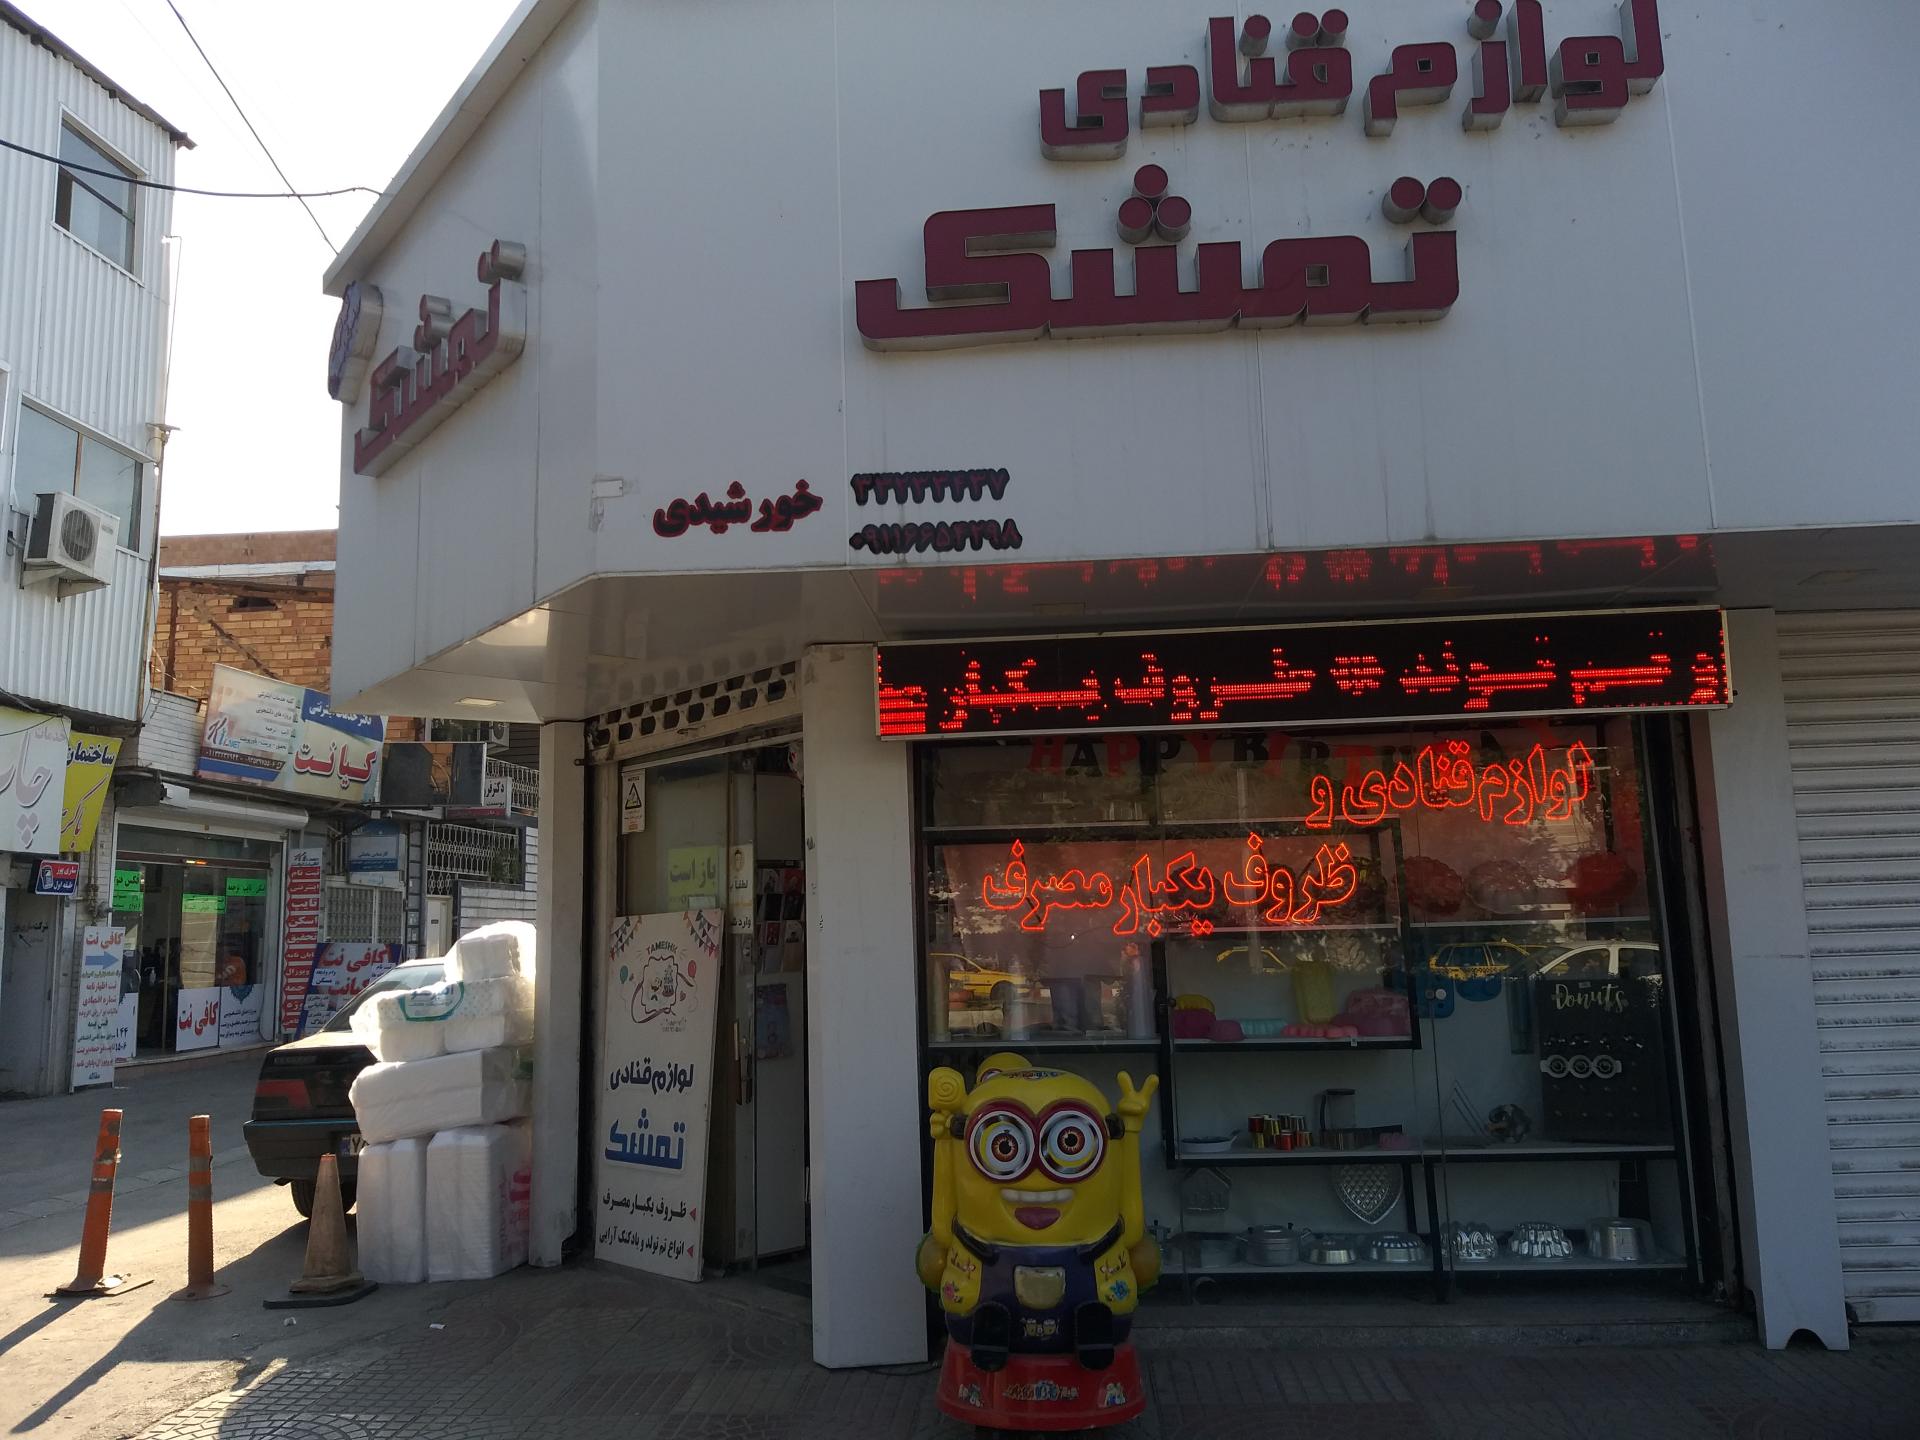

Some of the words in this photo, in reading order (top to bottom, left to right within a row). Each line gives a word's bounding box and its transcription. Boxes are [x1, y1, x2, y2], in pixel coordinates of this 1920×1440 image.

[1039, 8, 1353, 152] قنادی
[1362, 0, 1666, 130] لوازم
[855, 163, 1462, 345] تمشک
[354, 239, 516, 476] تمشک
[652, 479, 823, 538] خورشیدی
[1023, 733, 1218, 778] HAPPY
[1342, 739, 1477, 826] قنادی
[1478, 739, 1595, 825] لوازم
[1305, 774, 1335, 828] و
[698, 857, 717, 889] باز
[981, 838, 1114, 932] مصرف
[1223, 831, 1358, 924] ظروف
[291, 898, 317, 910] تایپ
[1113, 851, 1216, 937] یکبار
[288, 915, 317, 928] اسکن
[86, 934, 100, 946] نت
[101, 931, 123, 949] کافی
[320, 948, 344, 967] نت
[347, 946, 388, 973] کافی
[1553, 983, 1628, 1013] Donuts
[179, 1003, 193, 1030] نت
[194, 1000, 219, 1036] کافی
[610, 1056, 652, 1091] قنادی
[652, 1063, 694, 1095] لوازم
[604, 1107, 686, 1170] تمشک
[603, 1188, 630, 1211] مصرف
[630, 1193, 655, 1217] یکبار
[656, 1197, 687, 1222] ظروف
[667, 1240, 685, 1260] انواع
